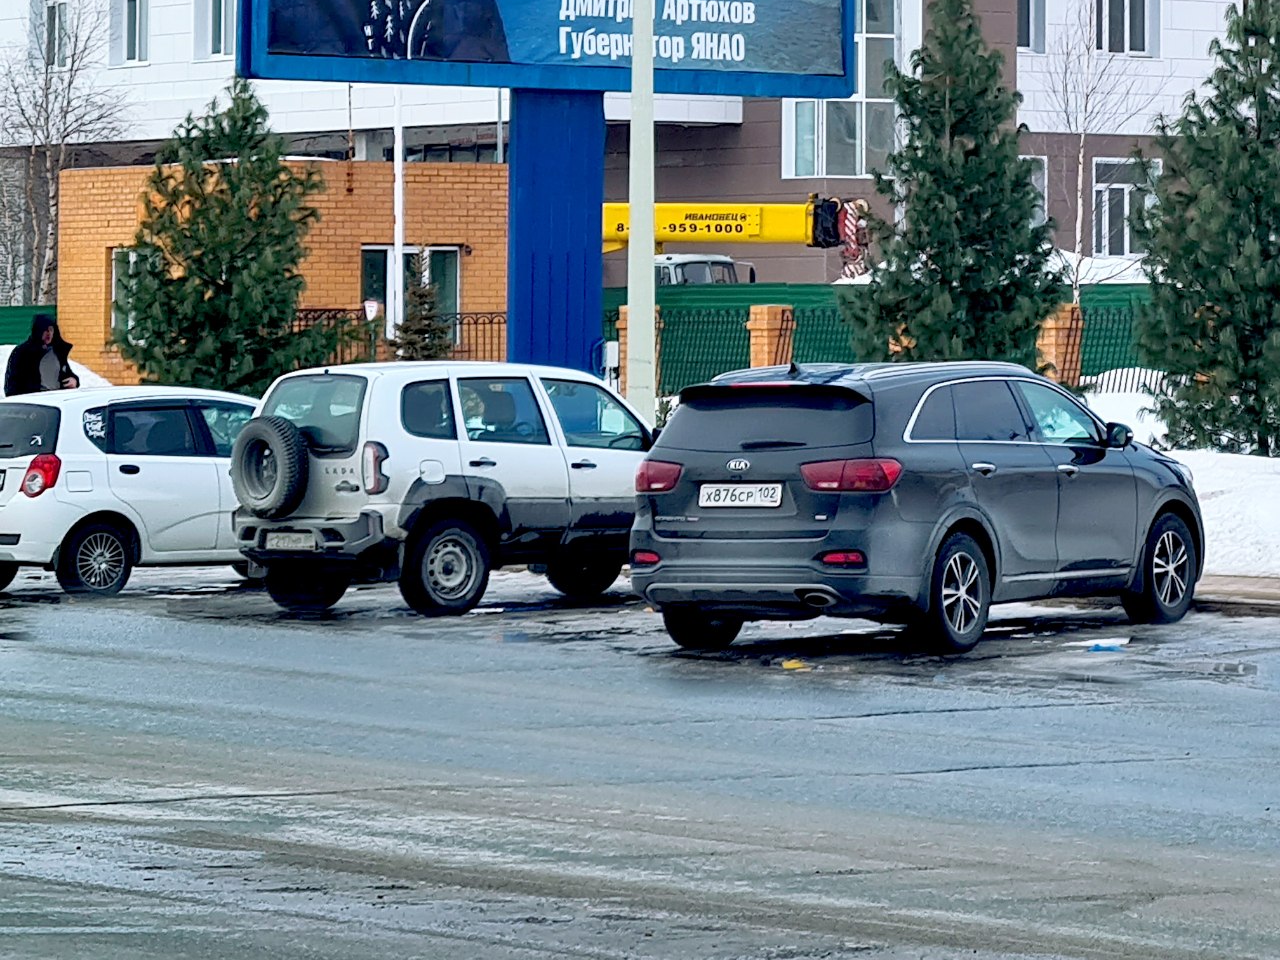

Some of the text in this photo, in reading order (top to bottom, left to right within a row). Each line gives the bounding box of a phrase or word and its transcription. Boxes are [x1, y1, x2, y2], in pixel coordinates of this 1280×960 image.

[559, 26, 746, 63] Губернтор ЯНАО
[684, 213, 739, 221] ИВАНОВЕЦ
